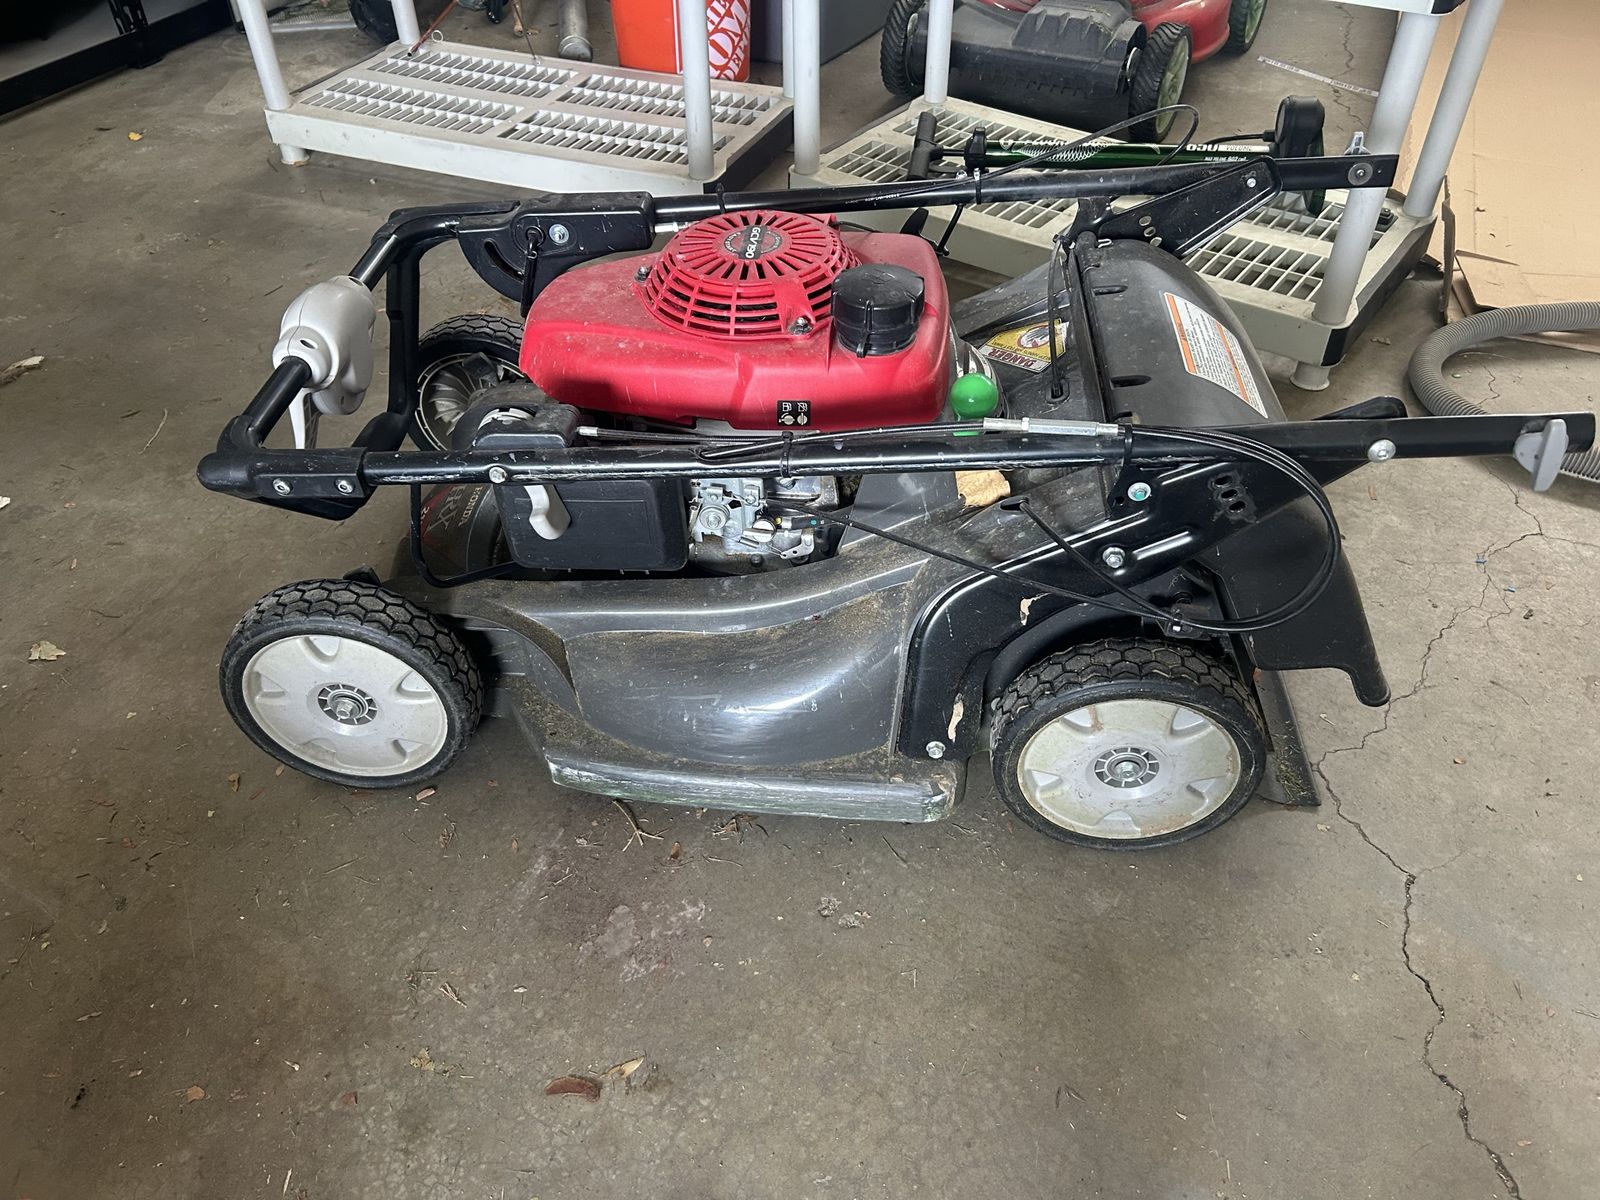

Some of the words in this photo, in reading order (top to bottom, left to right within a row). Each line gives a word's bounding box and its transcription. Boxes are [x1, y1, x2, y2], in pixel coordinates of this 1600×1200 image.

[745, 226, 761, 259] GCV190
[987, 347, 1037, 368] DANGER
[458, 486, 483, 527] HONDA
